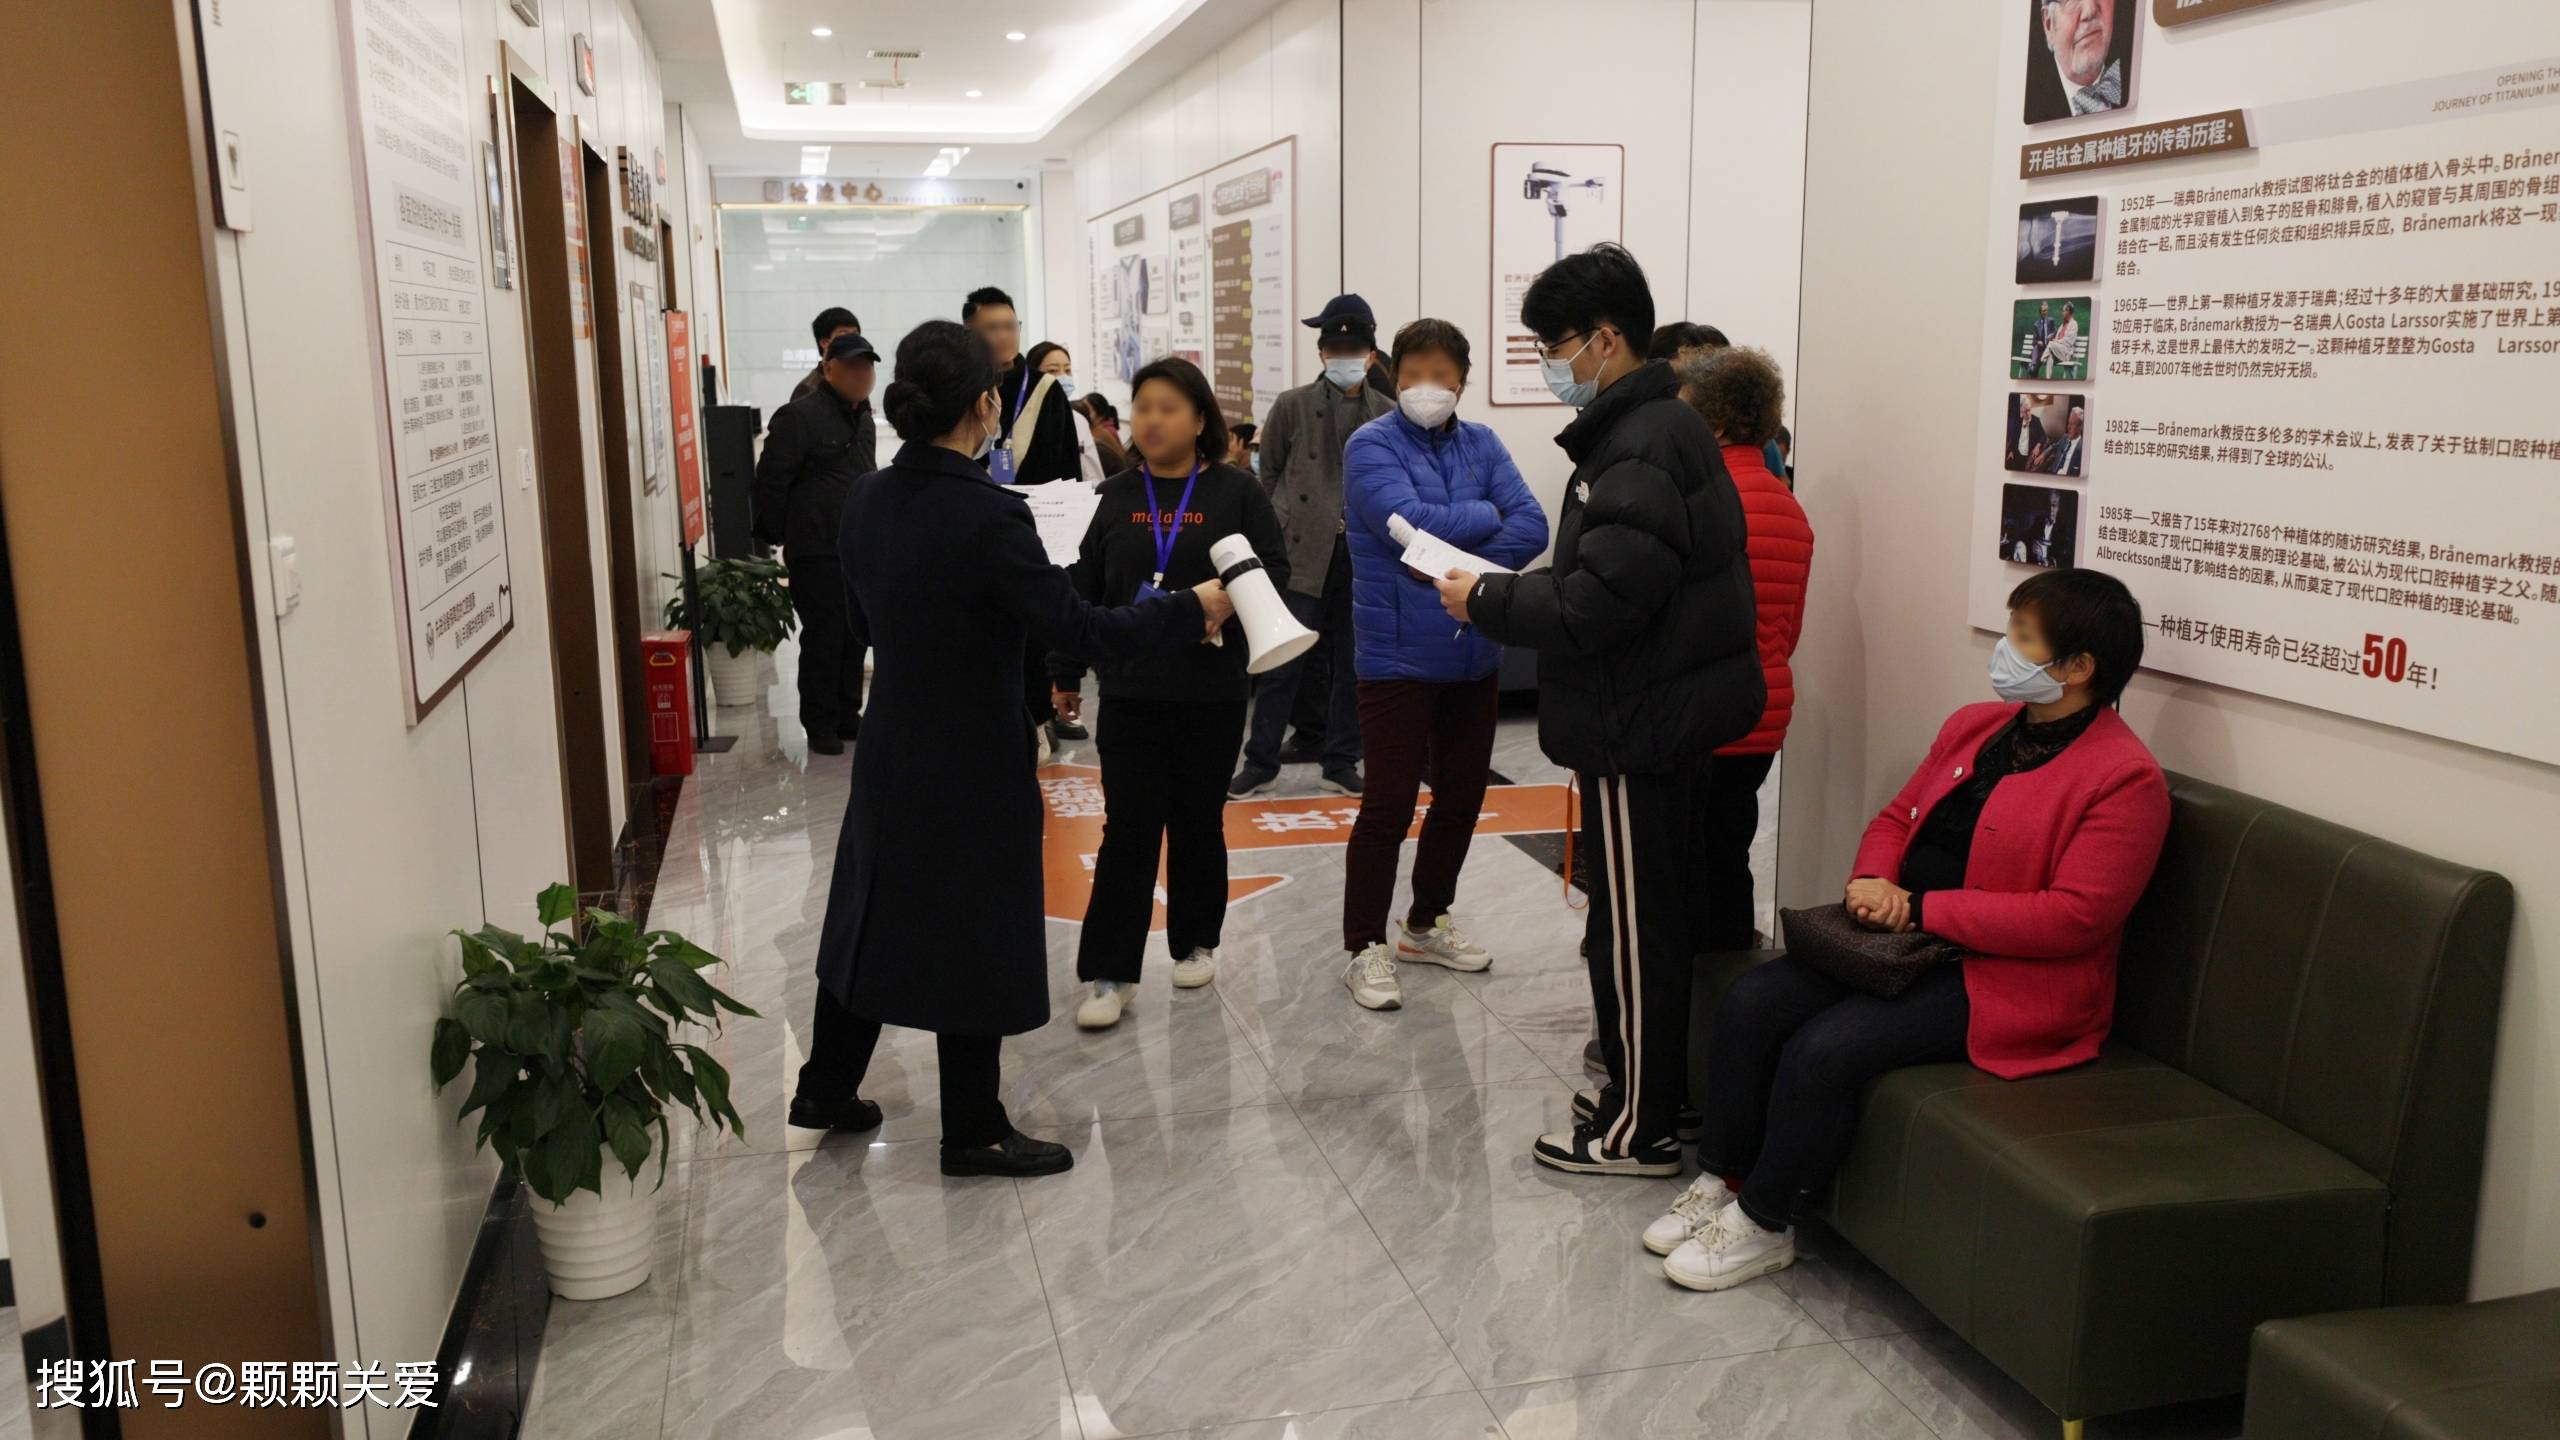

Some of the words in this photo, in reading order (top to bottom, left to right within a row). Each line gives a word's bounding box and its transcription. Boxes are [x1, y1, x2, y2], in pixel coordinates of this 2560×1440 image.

[2497, 69, 2544, 87] OPENING
[2432, 95, 2476, 112] JOURNEY
[2480, 93, 2493, 104] OF
[2496, 85, 2544, 102] TITANIUM
[2028, 118, 2234, 172] 开启钛金属种植牙的传奇历程：
[2117, 202, 2560, 256] 结合在一起，而且没有发生任何炎症和组织排异反应，Brånemark将这一现
[2116, 261, 2141, 276] 结合。
[2109, 360, 2318, 380] 42年，直到2007年他去世时仍然完好无损。
[2104, 439, 2334, 472] 结合的15年的研究结果，并得到了全球的公认。
[2098, 525, 2560, 604] 结合理论奠定了现代口种植学发展的理论基础，被公认为现代口腔种植学之父。随
